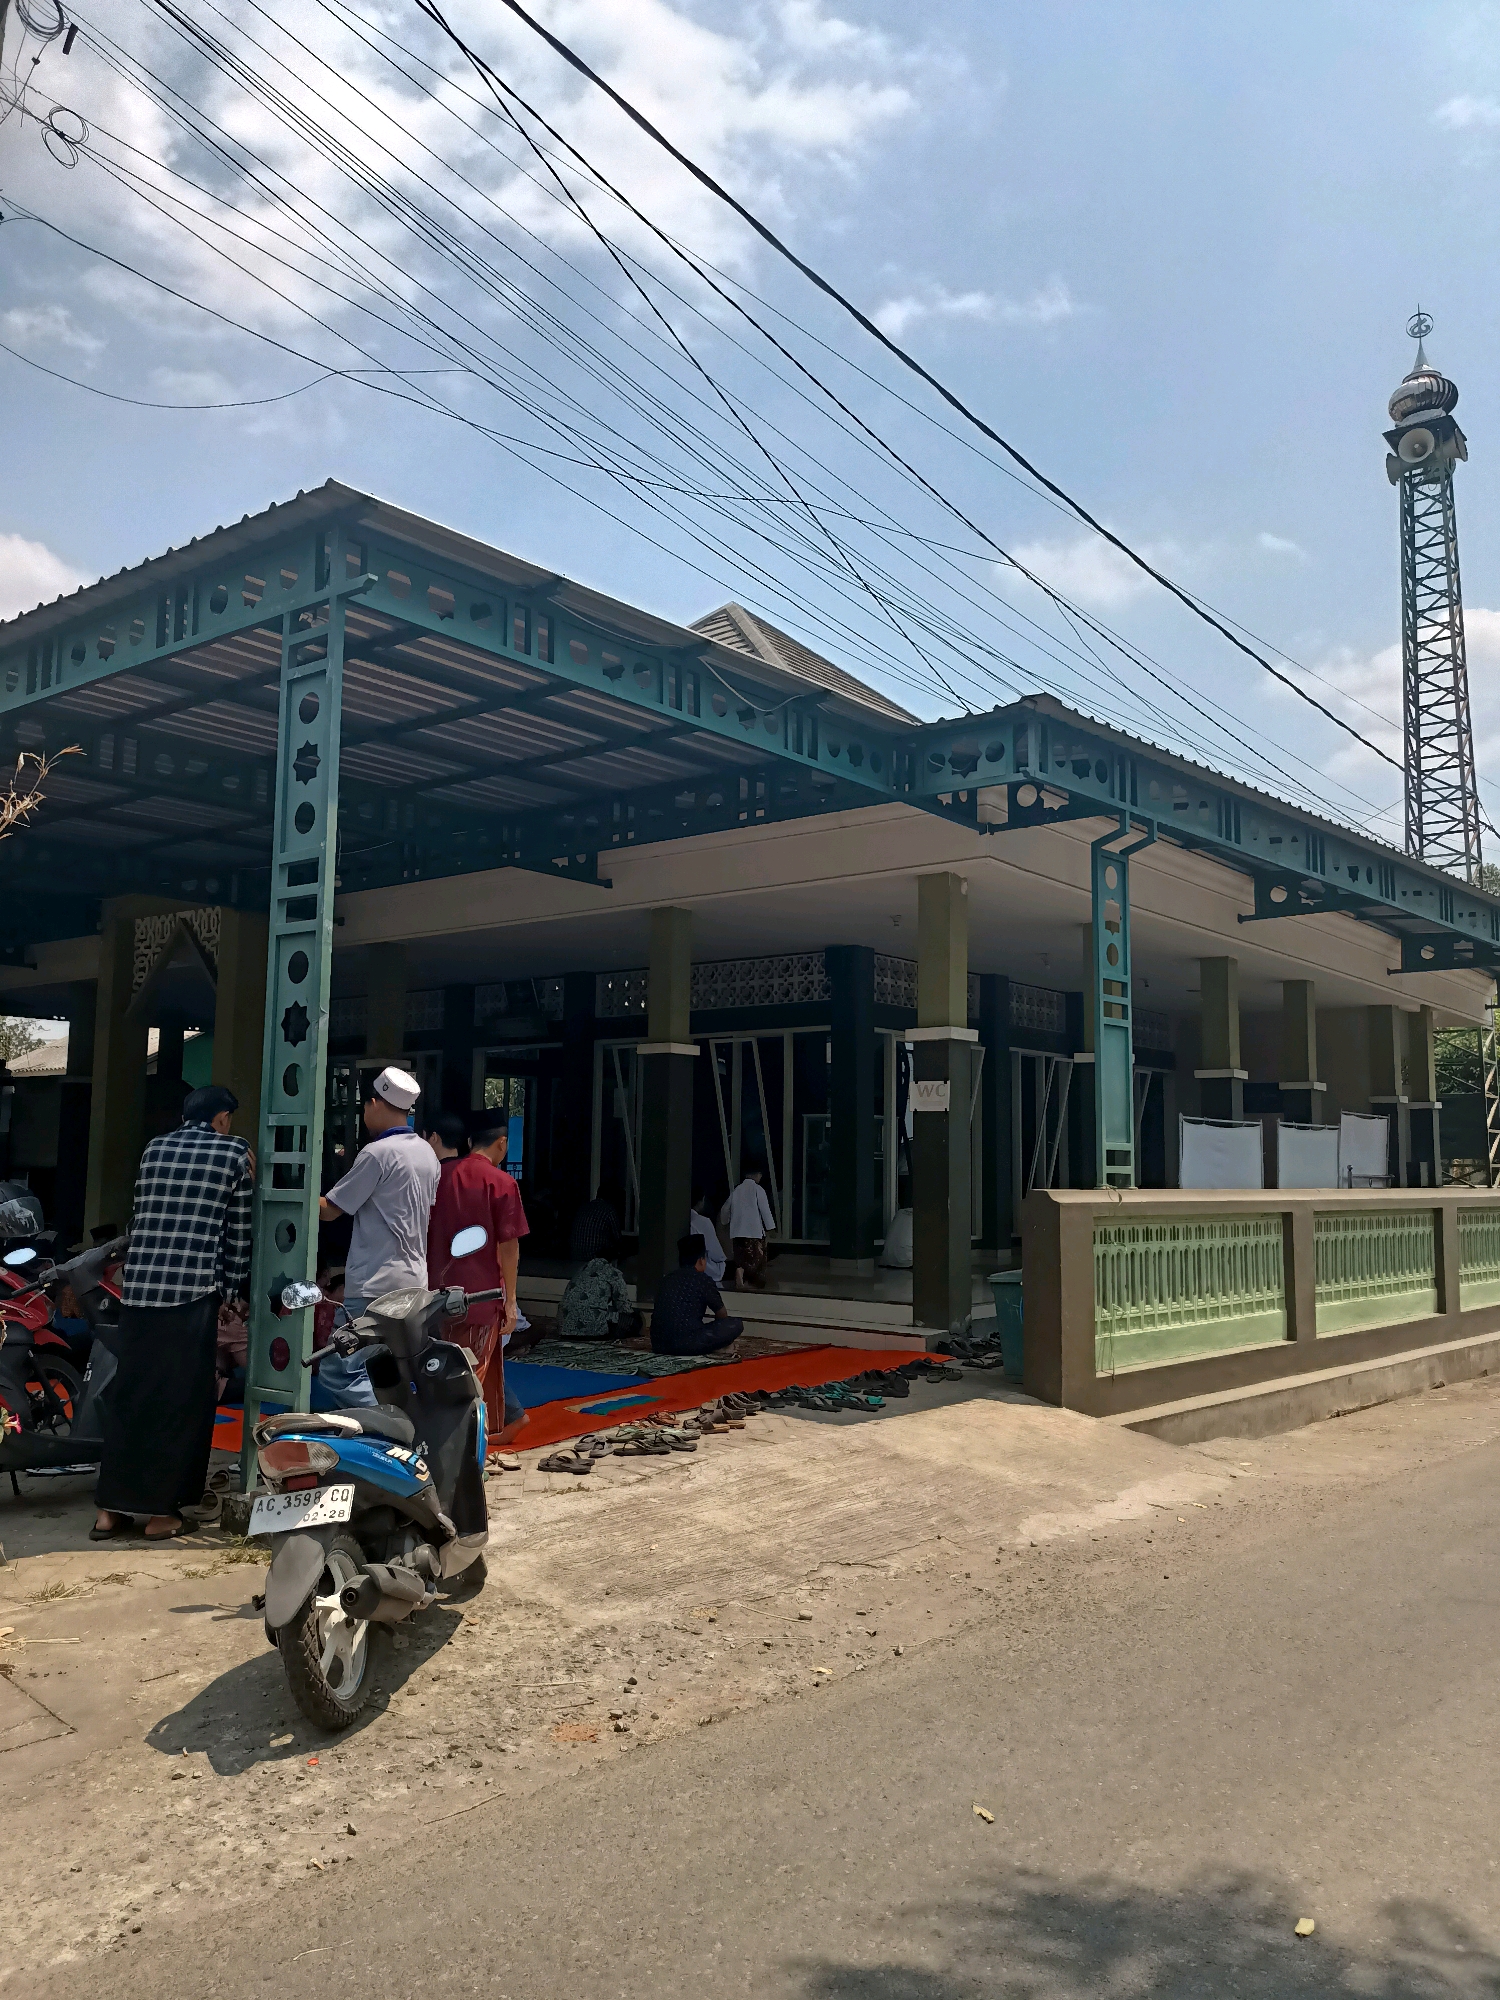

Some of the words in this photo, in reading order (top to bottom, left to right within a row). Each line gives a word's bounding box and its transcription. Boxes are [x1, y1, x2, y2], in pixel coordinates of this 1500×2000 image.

[916, 1083, 946, 1098] WC
[256, 1497, 276, 1513] AC
[282, 1490, 322, 1509] 3598
